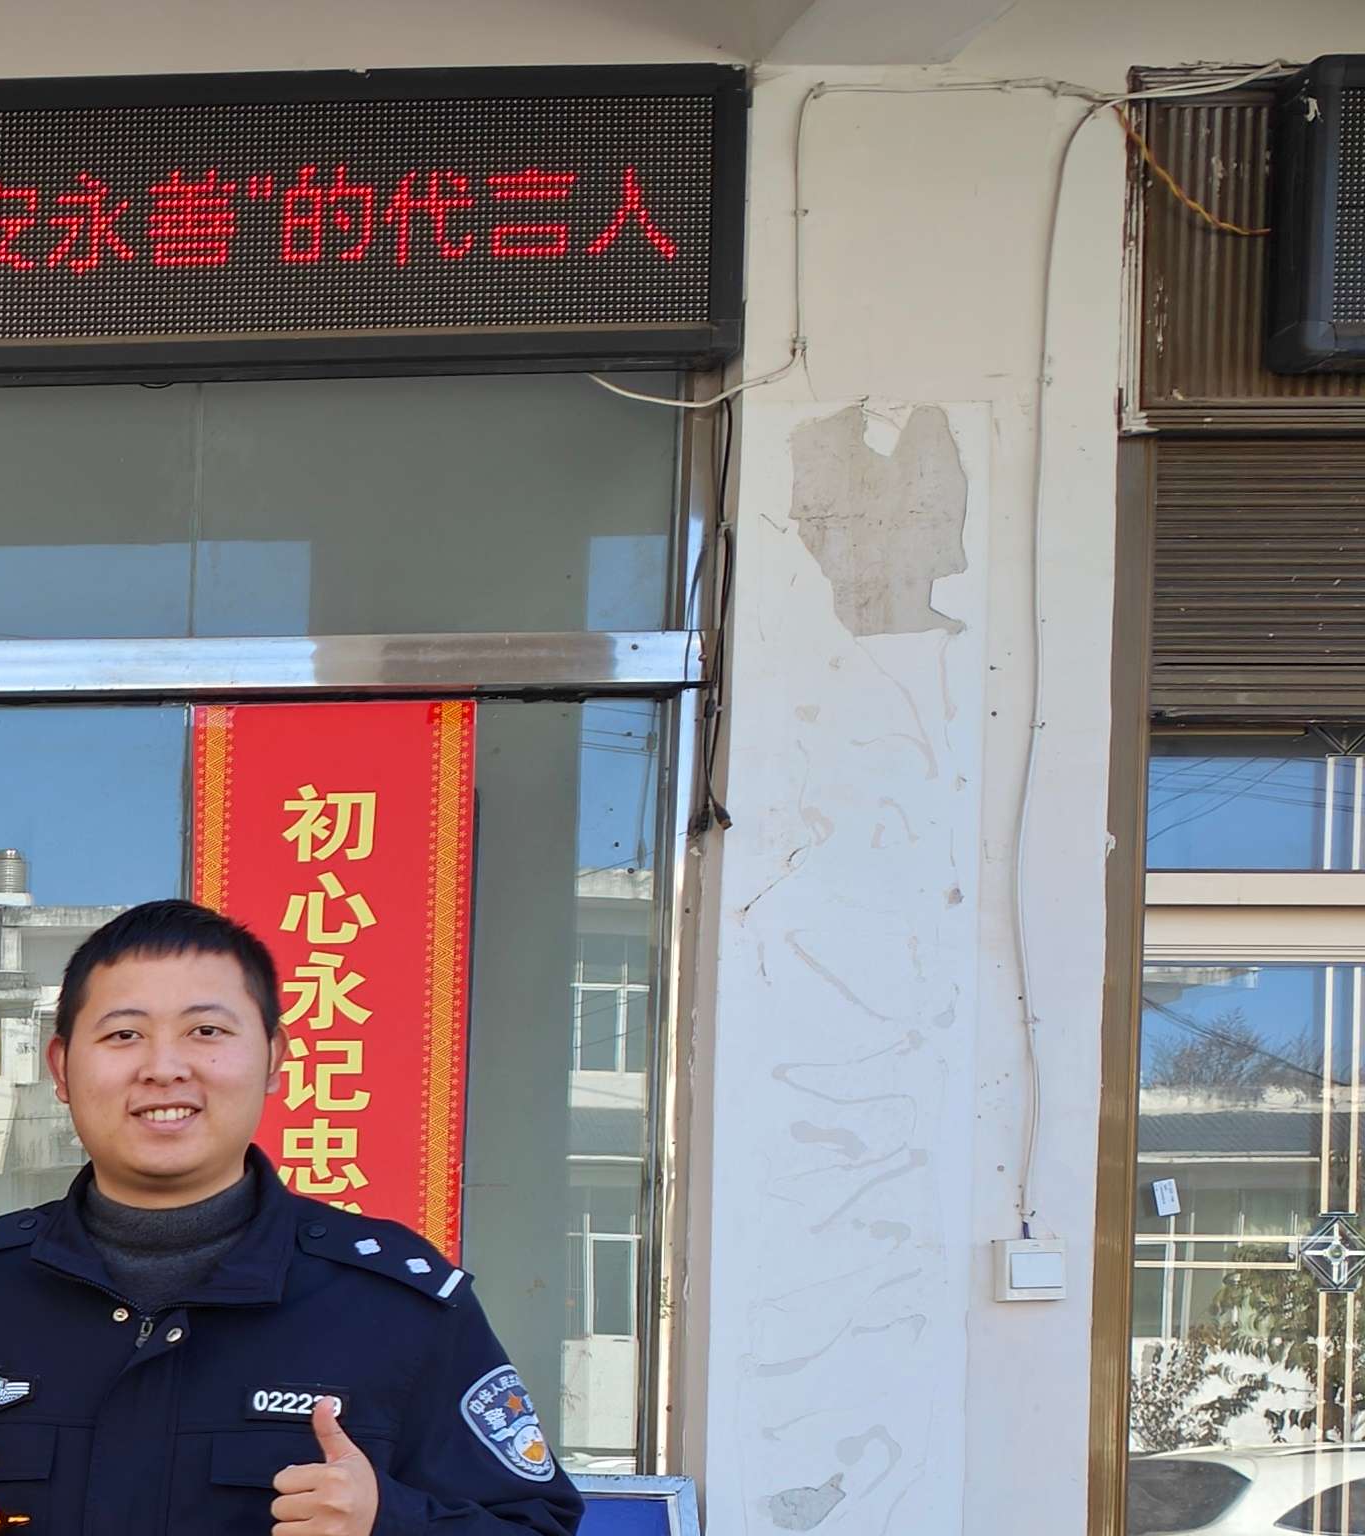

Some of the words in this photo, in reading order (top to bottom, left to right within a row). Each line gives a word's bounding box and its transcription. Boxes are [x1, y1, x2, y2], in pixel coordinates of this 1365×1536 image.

[277, 784, 378, 1214] 初心永记忠
